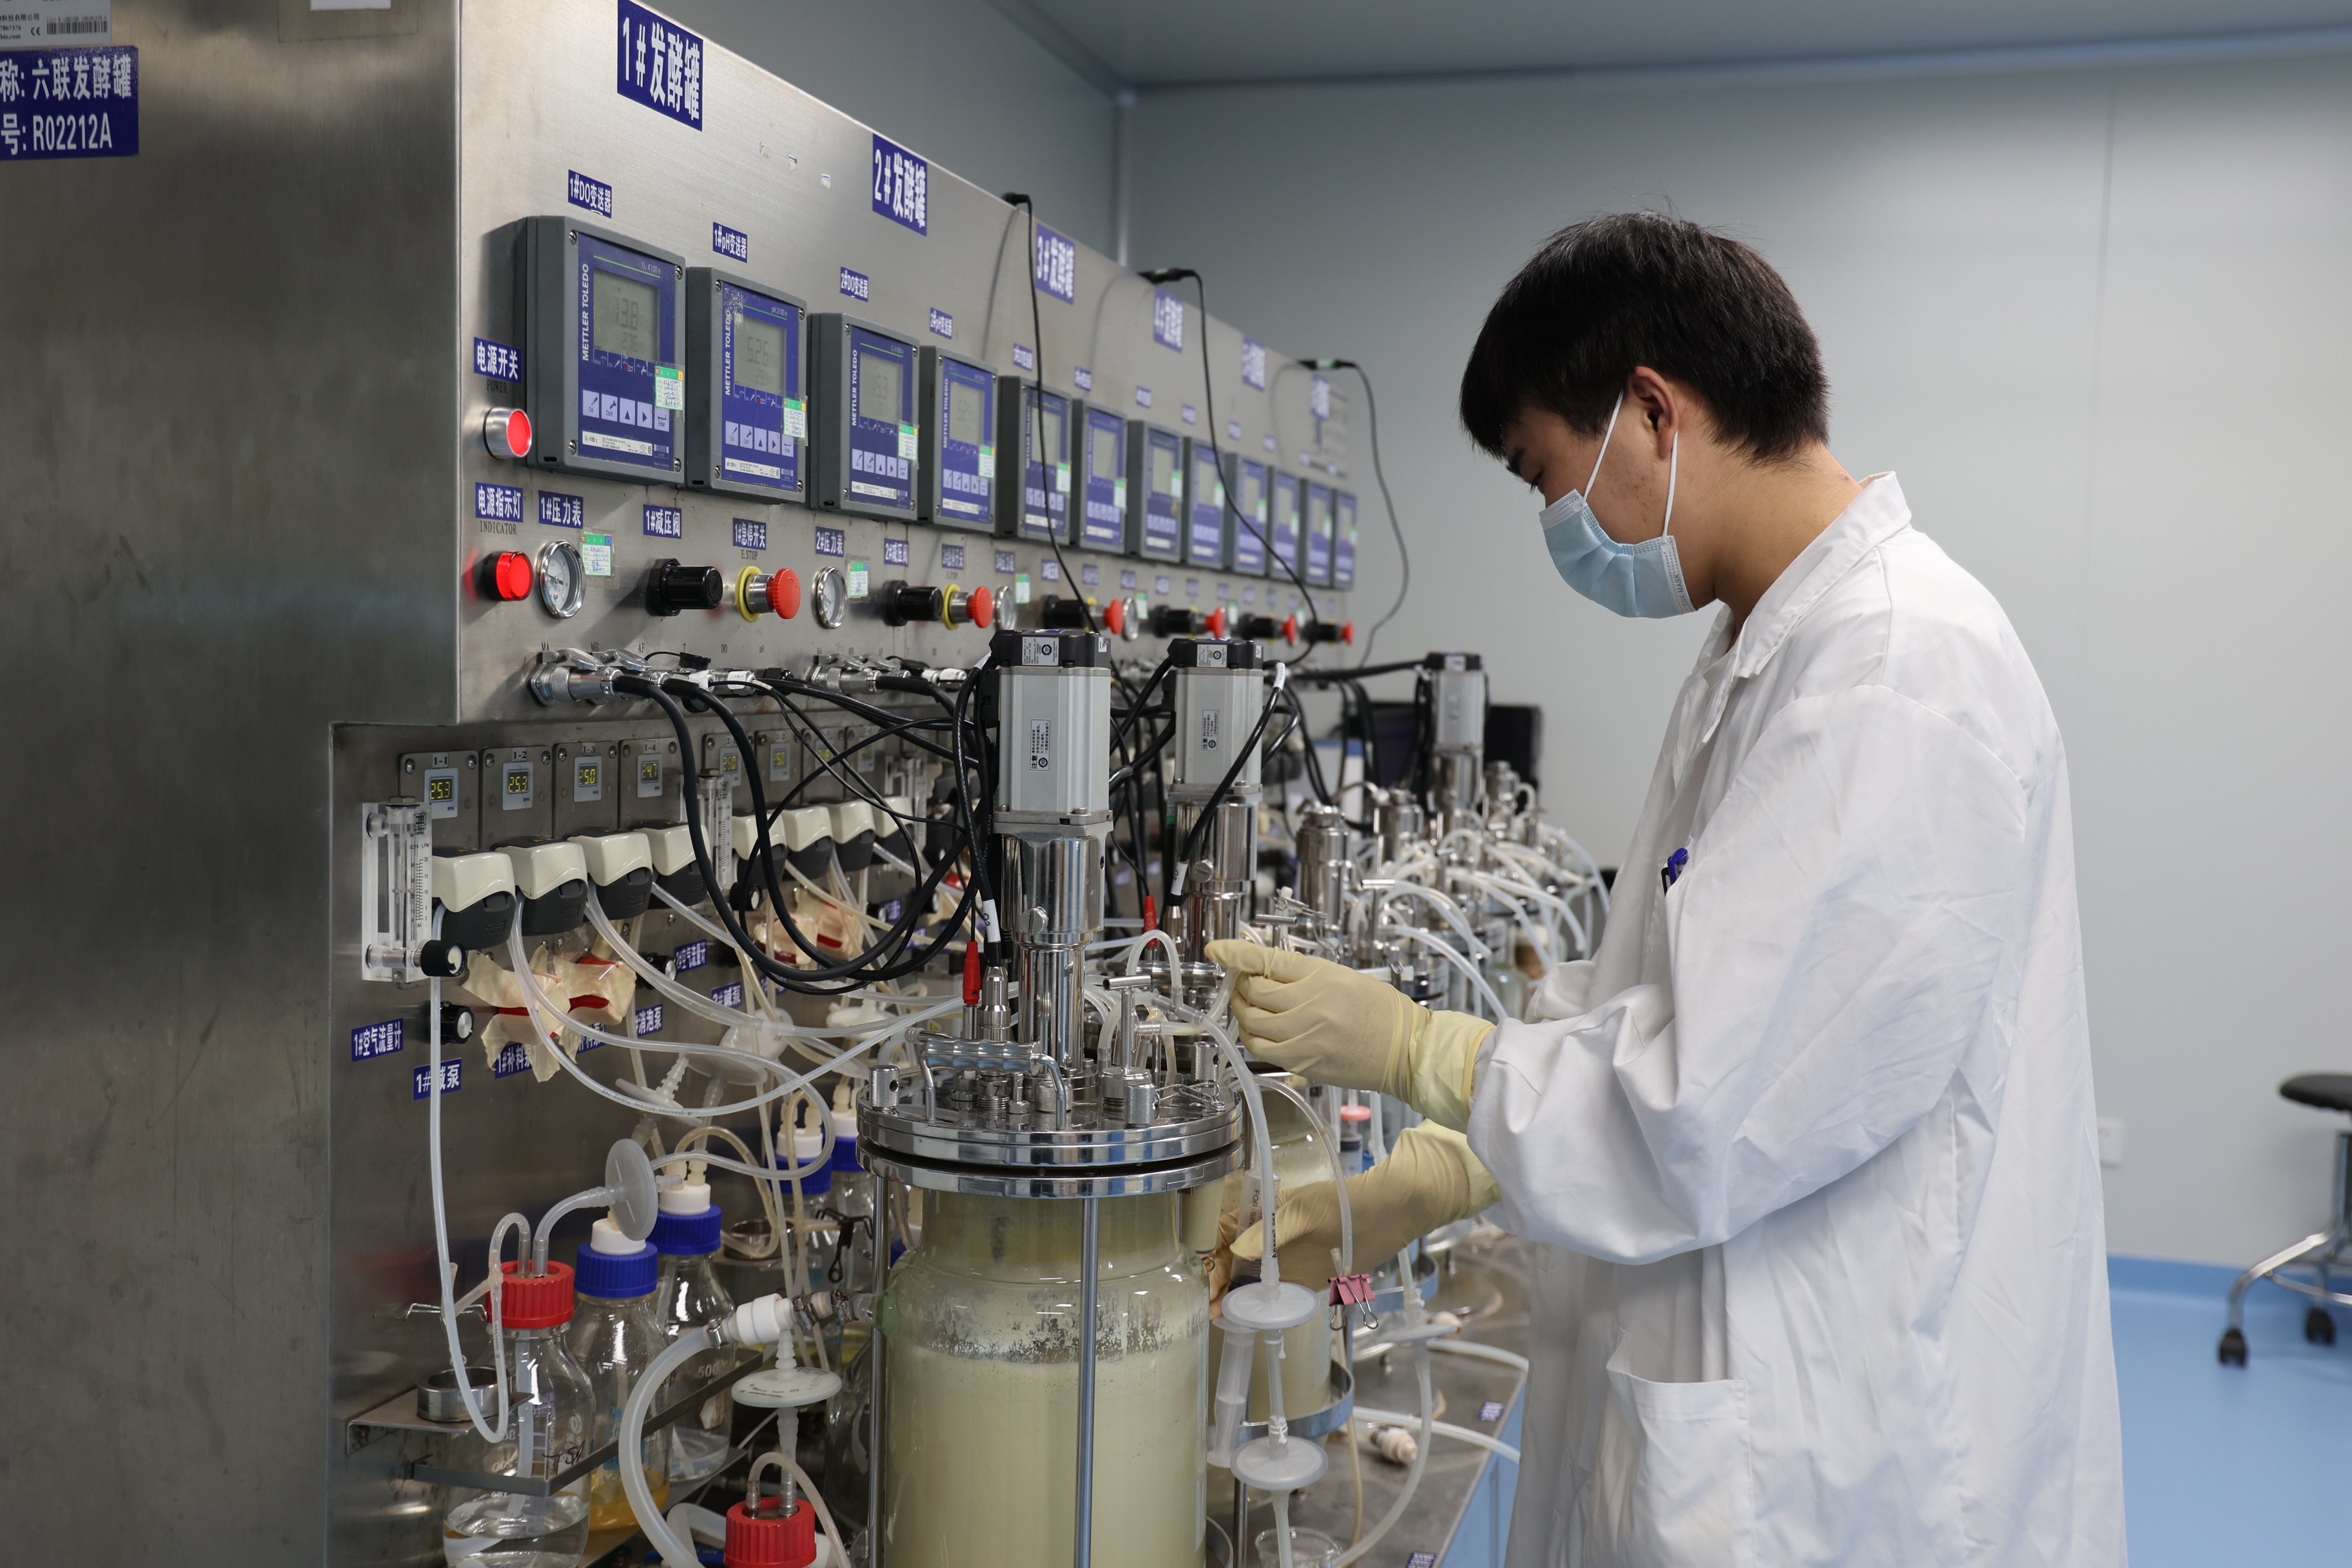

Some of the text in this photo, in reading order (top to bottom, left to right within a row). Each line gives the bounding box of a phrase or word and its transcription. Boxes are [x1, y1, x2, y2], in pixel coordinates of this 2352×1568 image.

[623, 17, 700, 121] 1#发酵罐
[570, 174, 611, 214] 1#DO变送器
[874, 148, 927, 229] 2#发酵罐
[714, 226, 747, 259] 1#pH变送器
[477, 341, 519, 380] 电源开关
[486, 378, 507, 395] POWER
[478, 485, 521, 518] 电源指示灯
[541, 497, 582, 527] 1#压力表
[480, 520, 517, 535] INDICATOR
[645, 509, 680, 538] 1#减压阀
[734, 522, 765, 548] 1#急停开关
[741, 549, 758, 560] E.STOP
[816, 531, 843, 555] 2#压力表
[433, 756, 447, 765] 1-1
[513, 751, 527, 760] 1-2
[1031, 755, 1037, 769] 注意
[354, 1020, 402, 1057] 1#空气流量计
